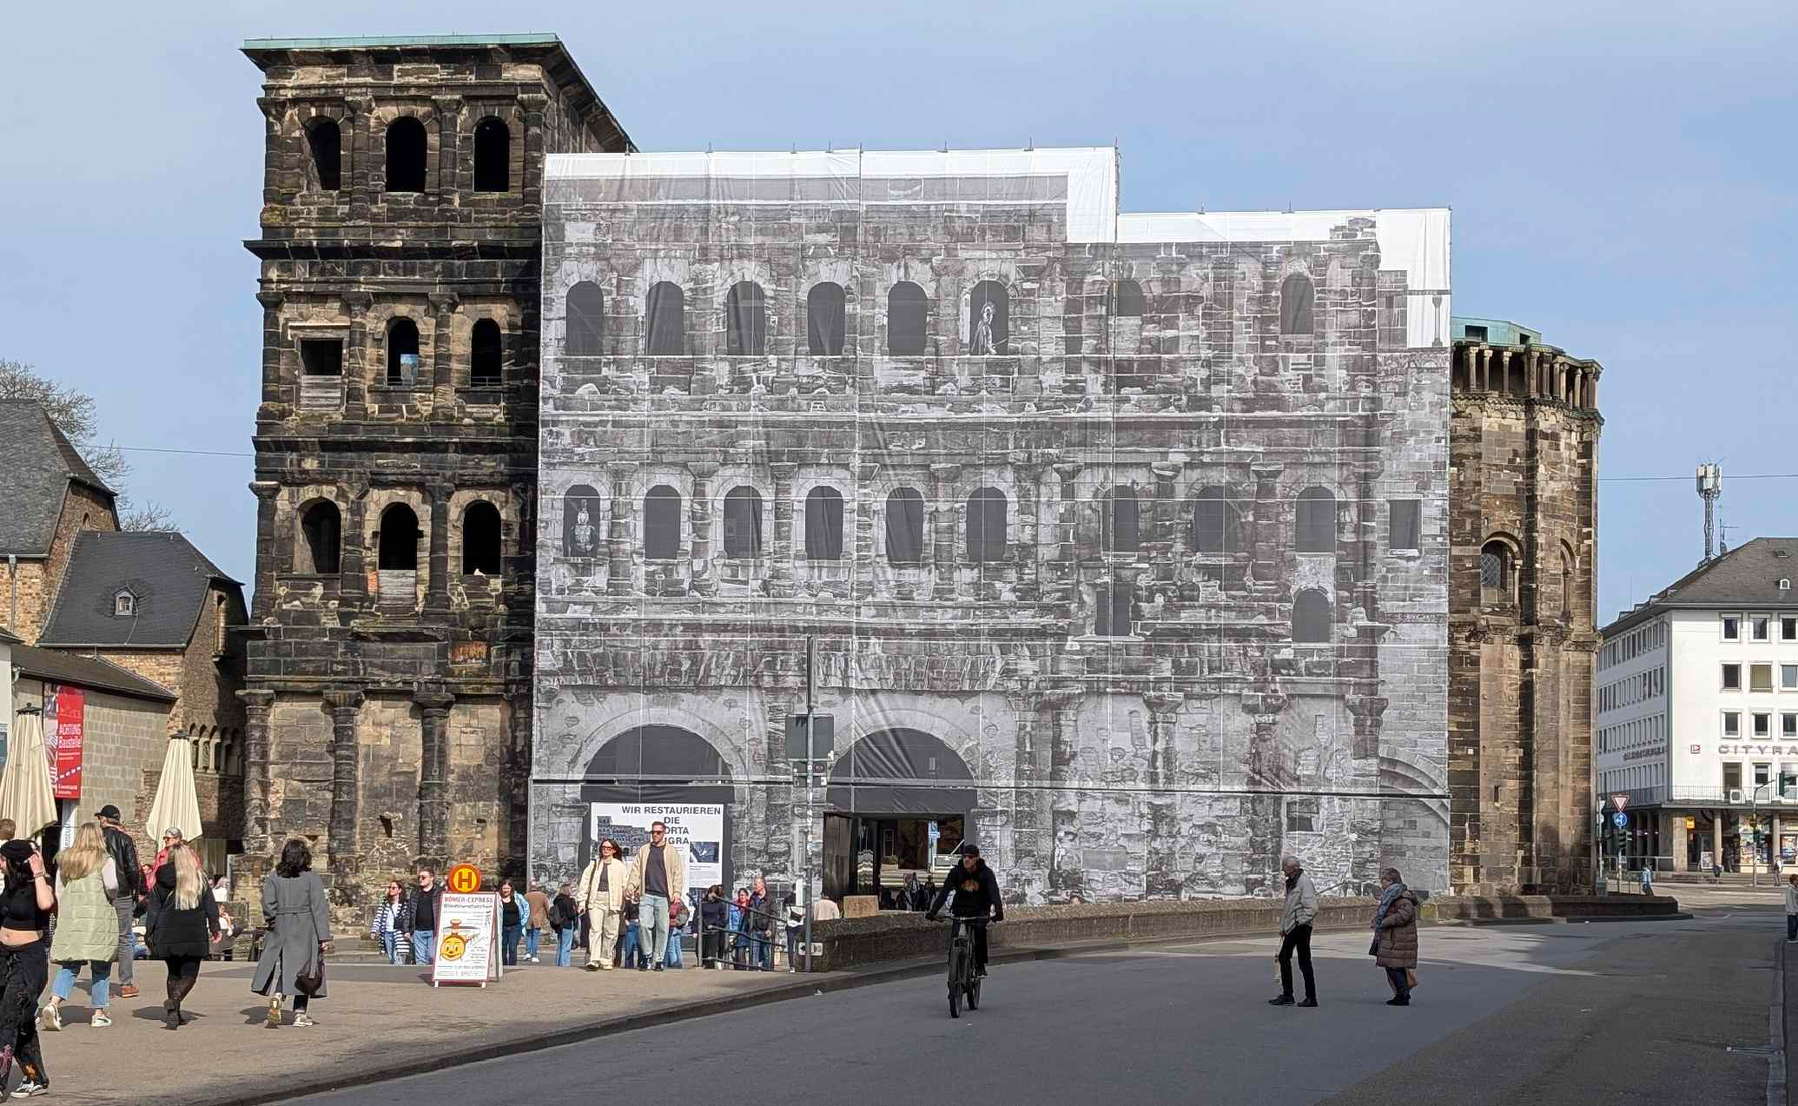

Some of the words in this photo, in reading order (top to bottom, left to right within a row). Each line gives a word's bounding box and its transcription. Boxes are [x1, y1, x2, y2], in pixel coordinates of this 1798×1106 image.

[621, 805, 641, 814] WIR
[644, 806, 721, 815] RESTAURIEREN
[663, 816, 680, 824] DIE
[664, 826, 689, 835] ORTA
[457, 871, 473, 889] H
